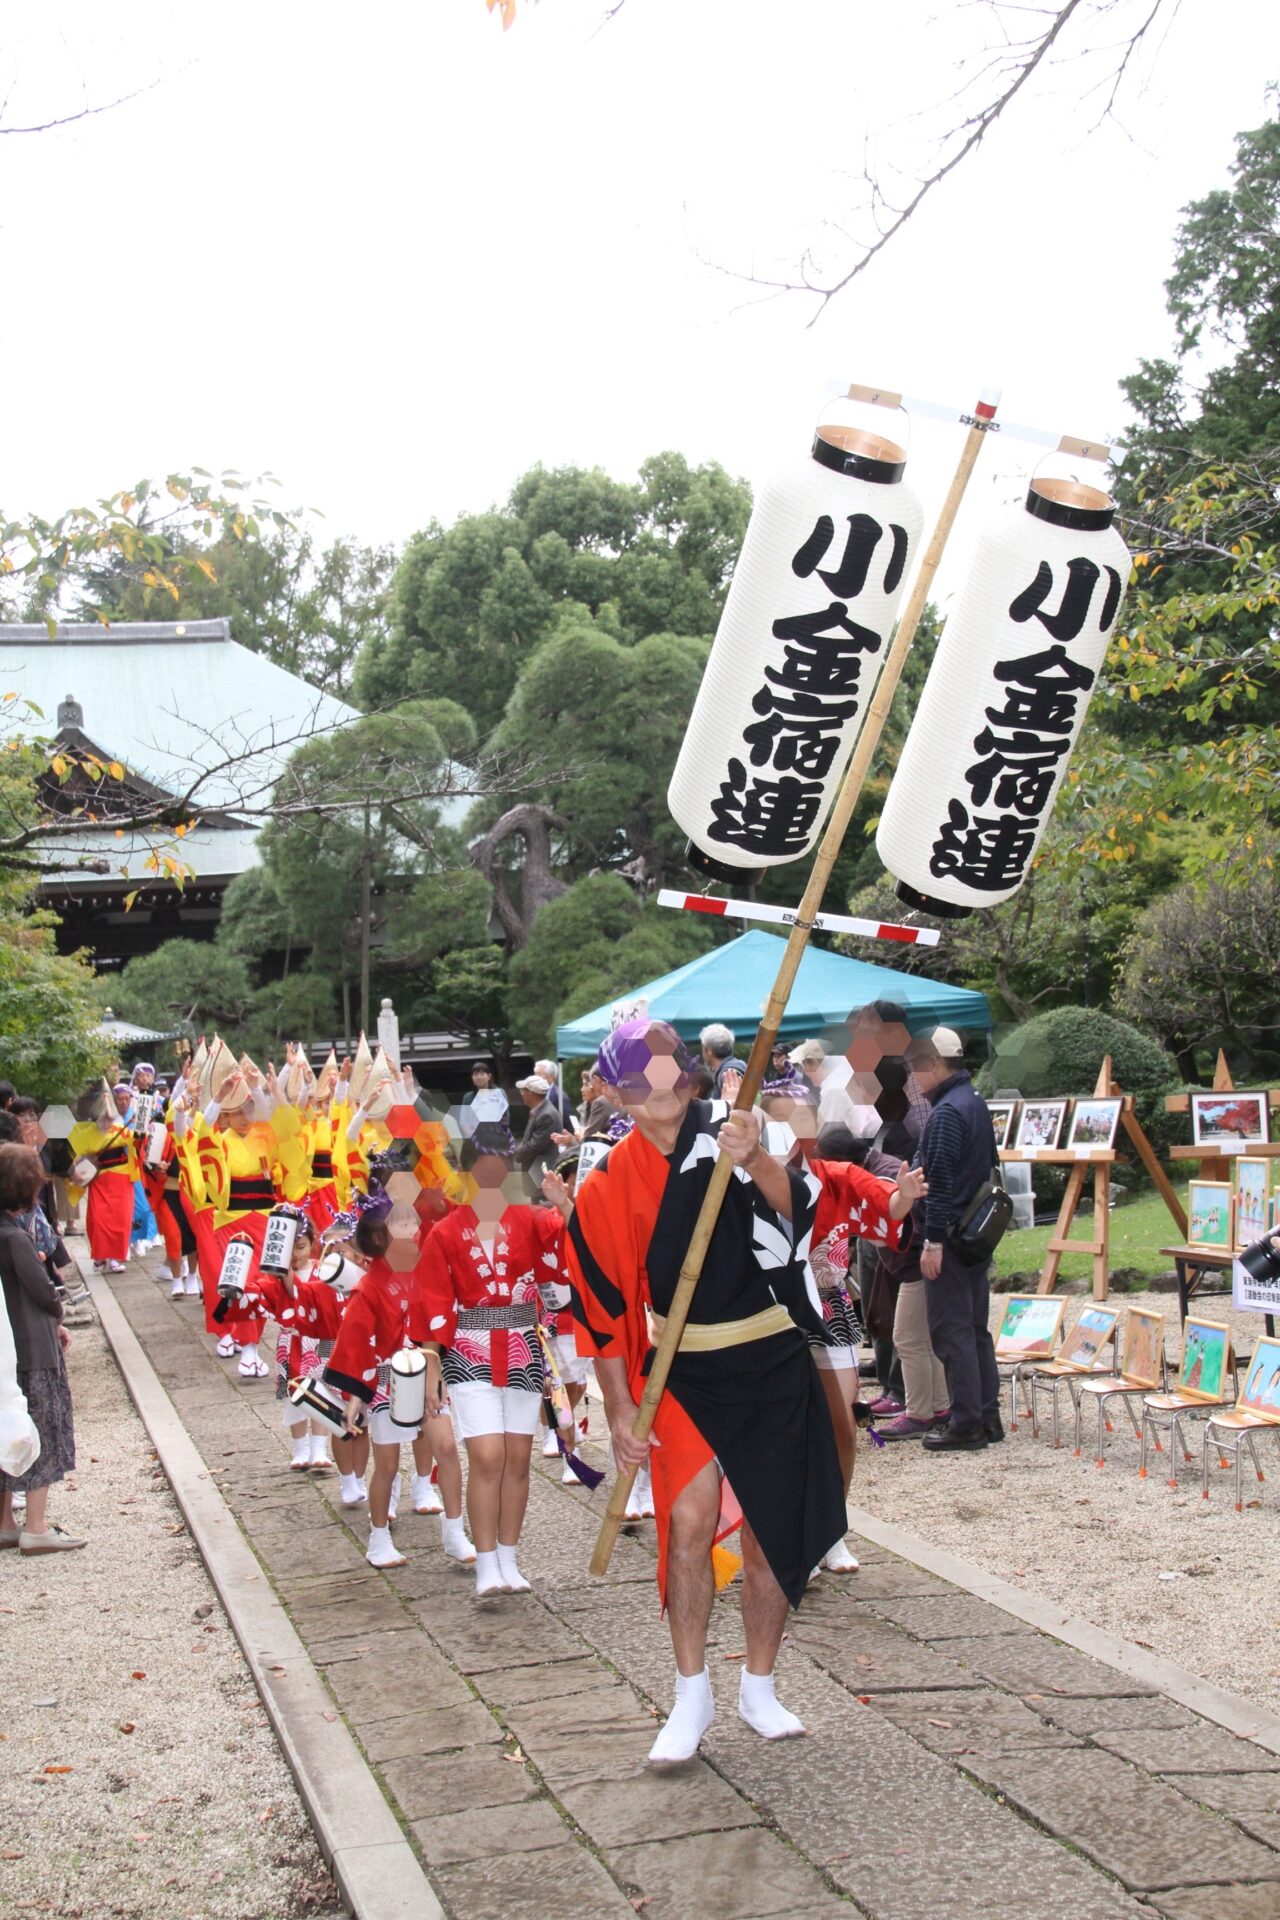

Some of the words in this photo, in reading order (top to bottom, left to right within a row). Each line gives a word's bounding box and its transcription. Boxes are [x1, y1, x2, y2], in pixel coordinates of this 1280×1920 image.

[707, 513, 907, 856] 小金宿連
[930, 557, 1121, 891] 小金宿連
